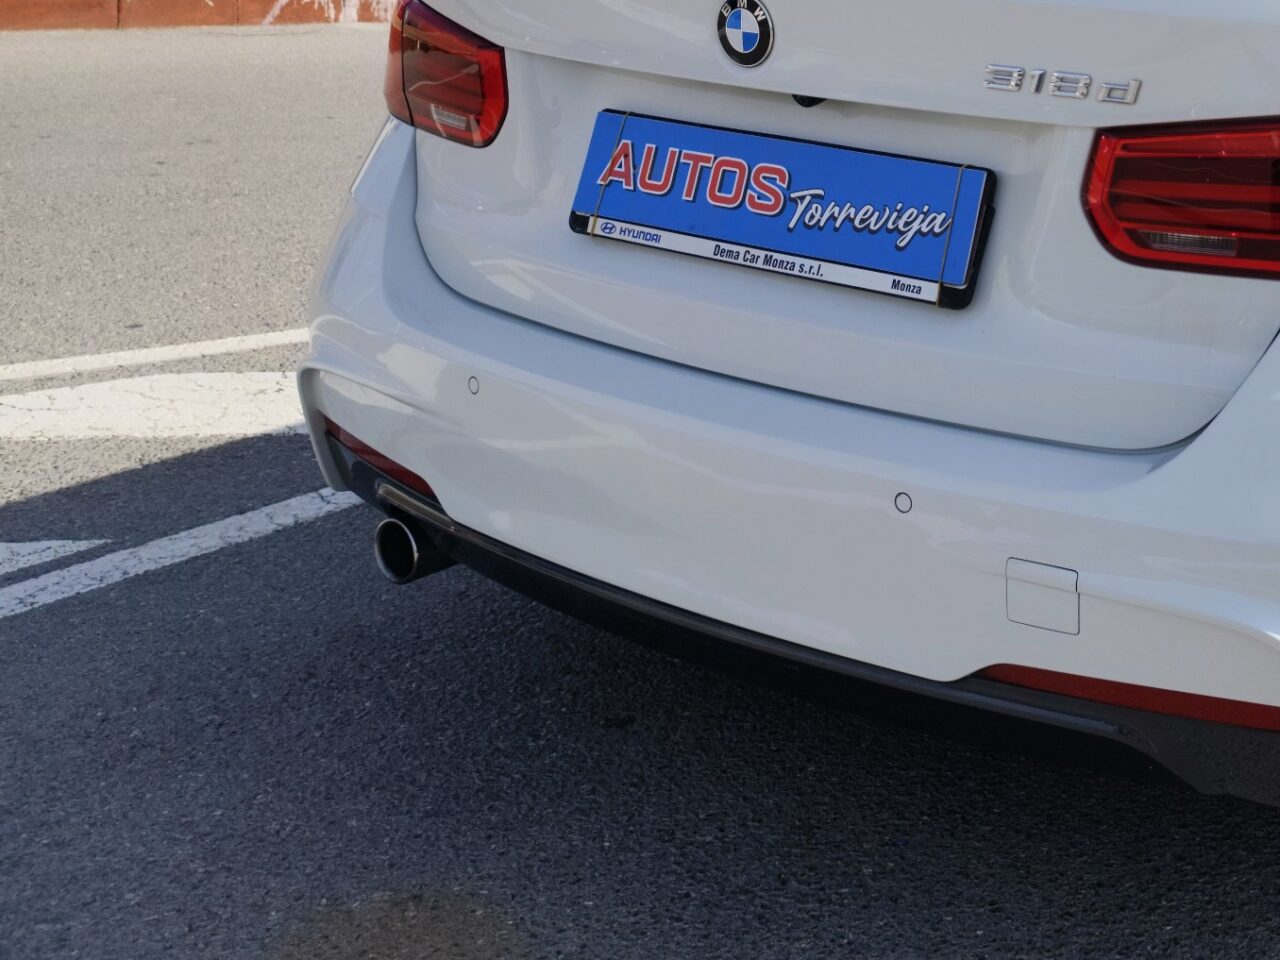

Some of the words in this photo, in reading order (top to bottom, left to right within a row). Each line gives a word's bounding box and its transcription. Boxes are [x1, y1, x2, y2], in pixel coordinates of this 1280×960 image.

[597, 139, 790, 216] AUTOS
[619, 226, 662, 244] HYUNDAI
[789, 189, 952, 248] Torrevieja
[713, 244, 740, 261] Dema
[743, 251, 761, 265] Car
[763, 254, 796, 272] Monza
[798, 263, 824, 278] s.r.l.
[891, 278, 922, 295] Monza
